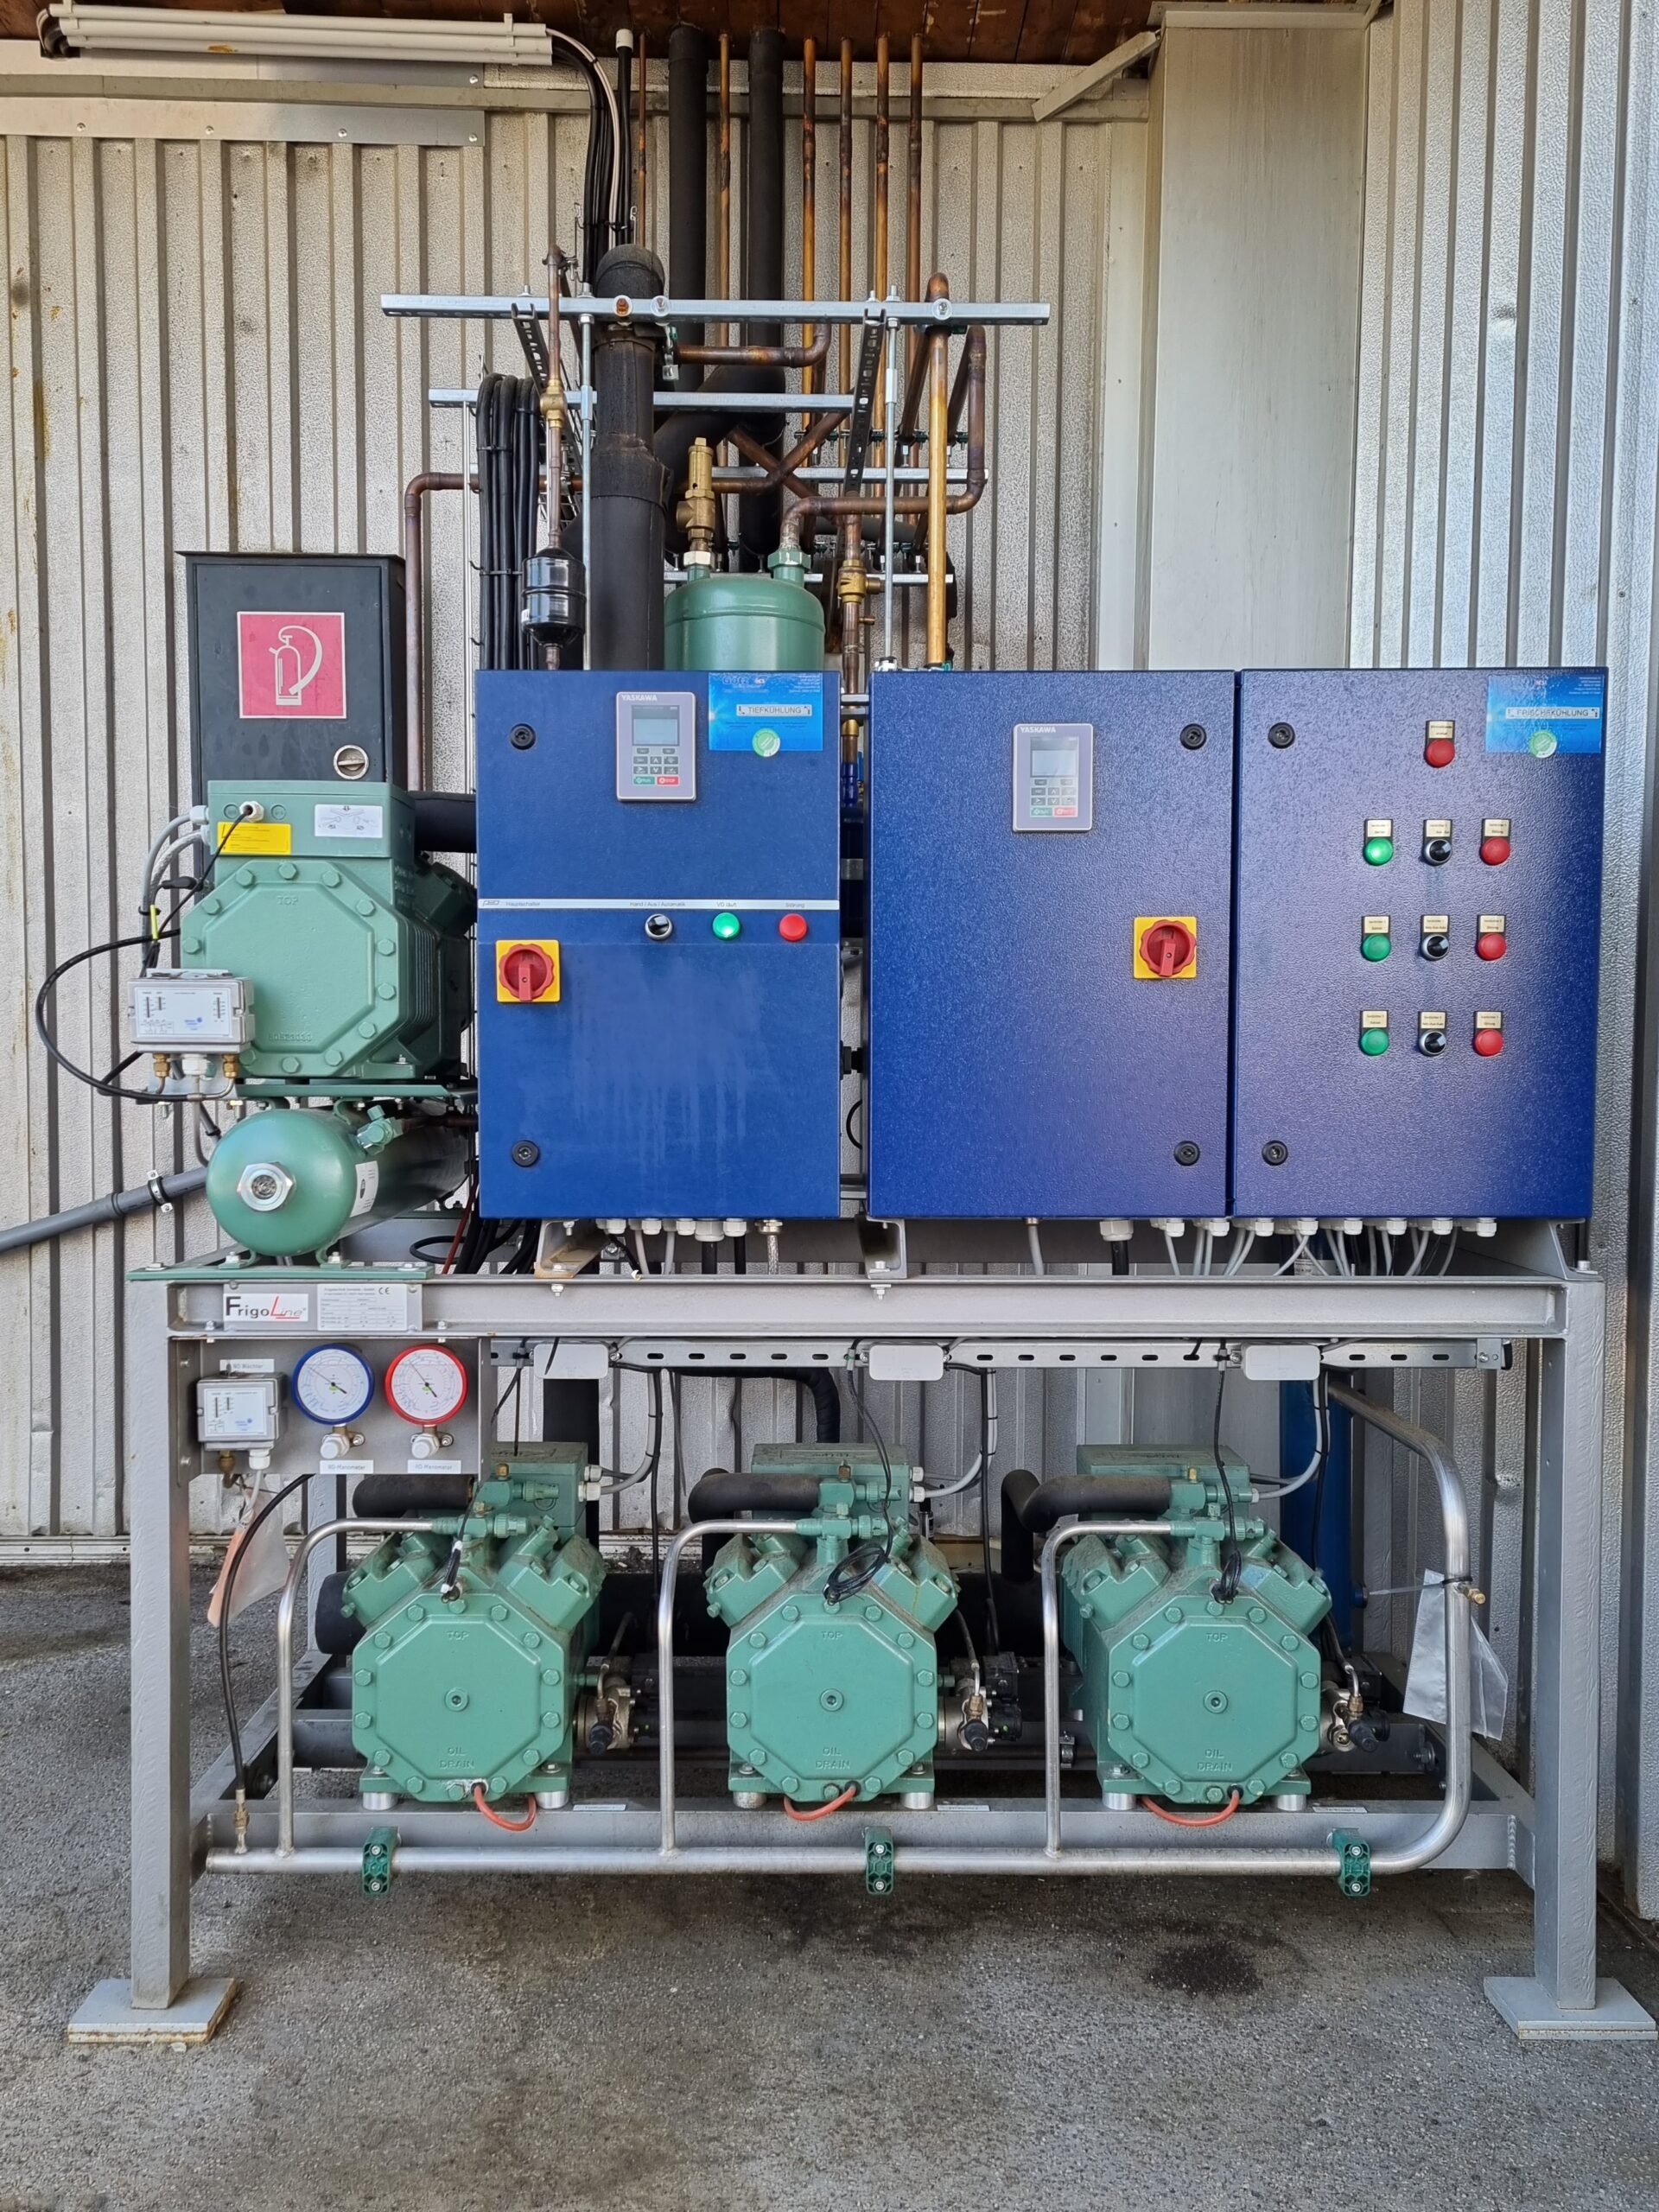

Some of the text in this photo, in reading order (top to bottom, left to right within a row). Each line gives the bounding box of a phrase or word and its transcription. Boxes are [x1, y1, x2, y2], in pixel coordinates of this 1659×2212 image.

[276, 895, 298, 906] TOP
[446, 1630, 469, 1641] TOP
[821, 1630, 843, 1641] TOP
[1206, 1632, 1229, 1643] TOP
[448, 1746, 467, 1757] OIL
[823, 1746, 842, 1757] OIL
[1205, 1749, 1224, 1758] OIL
[440, 1759, 475, 1770] DRAIN
[815, 1760, 850, 1770] DRAIN
[1197, 1762, 1232, 1771] DRAIN
